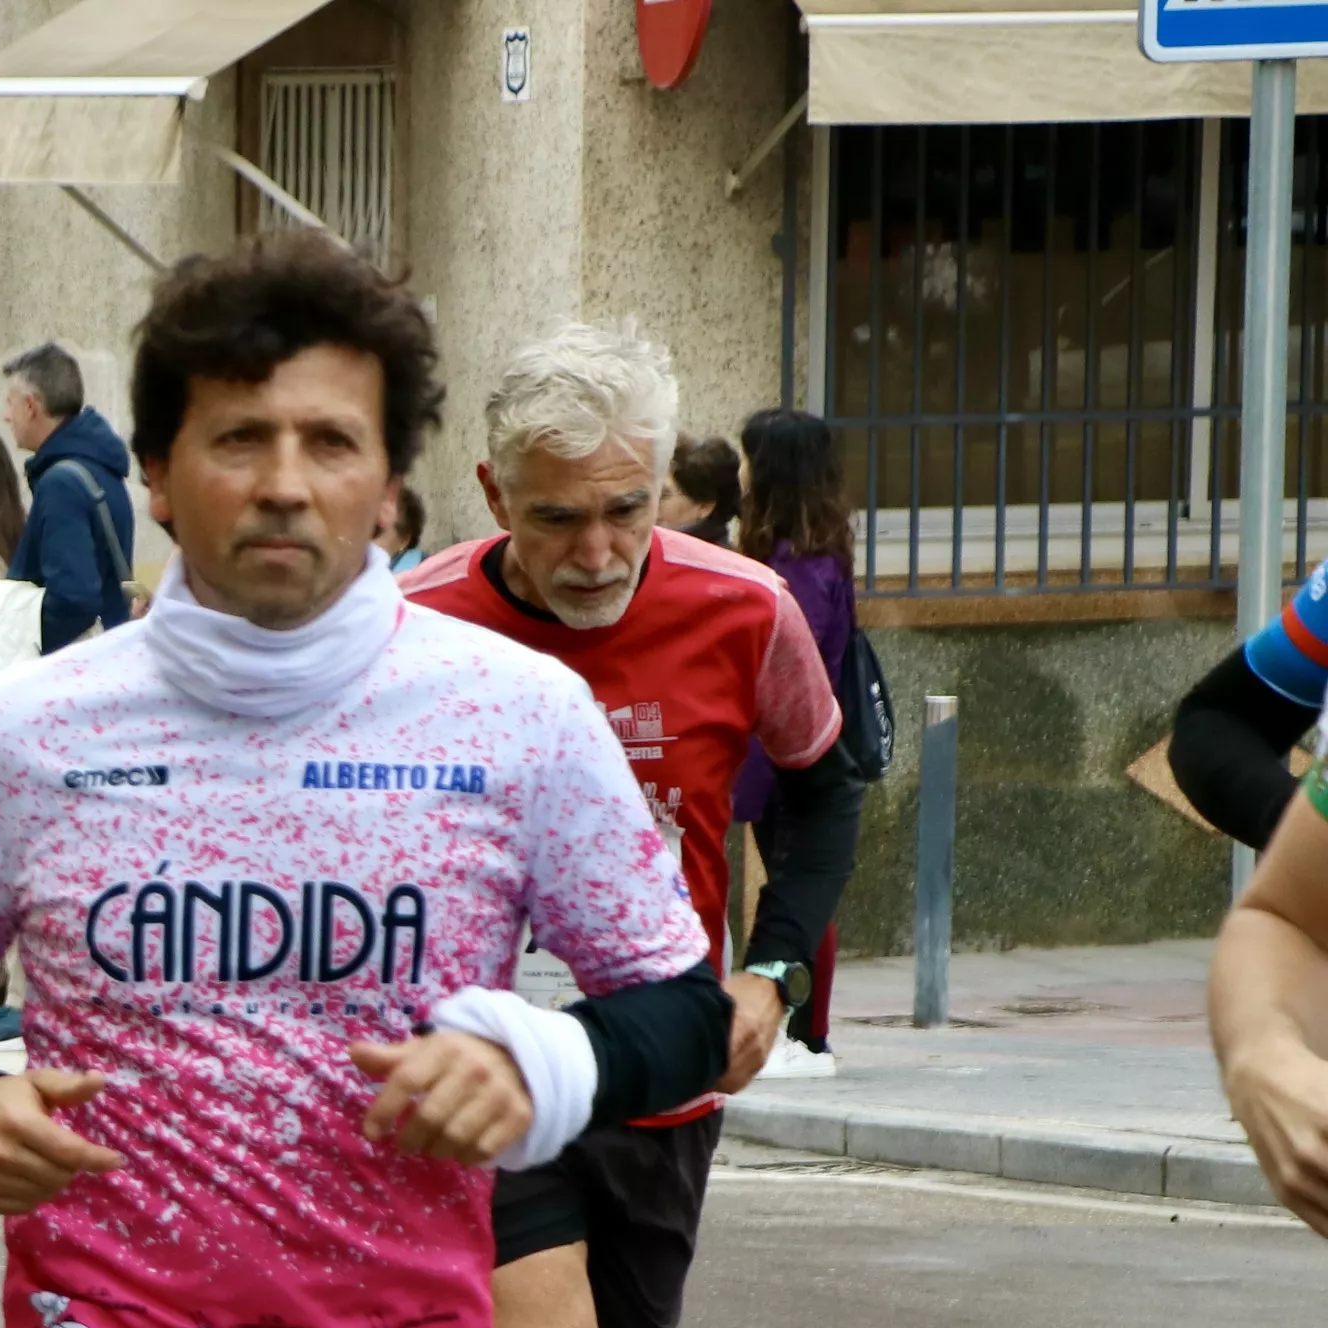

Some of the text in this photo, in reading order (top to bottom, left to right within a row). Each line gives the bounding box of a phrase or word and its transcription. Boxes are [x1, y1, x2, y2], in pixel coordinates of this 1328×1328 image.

[302, 760, 486, 794] ALBERTO ZAR
[86, 860, 427, 985] CÁNDIDA
